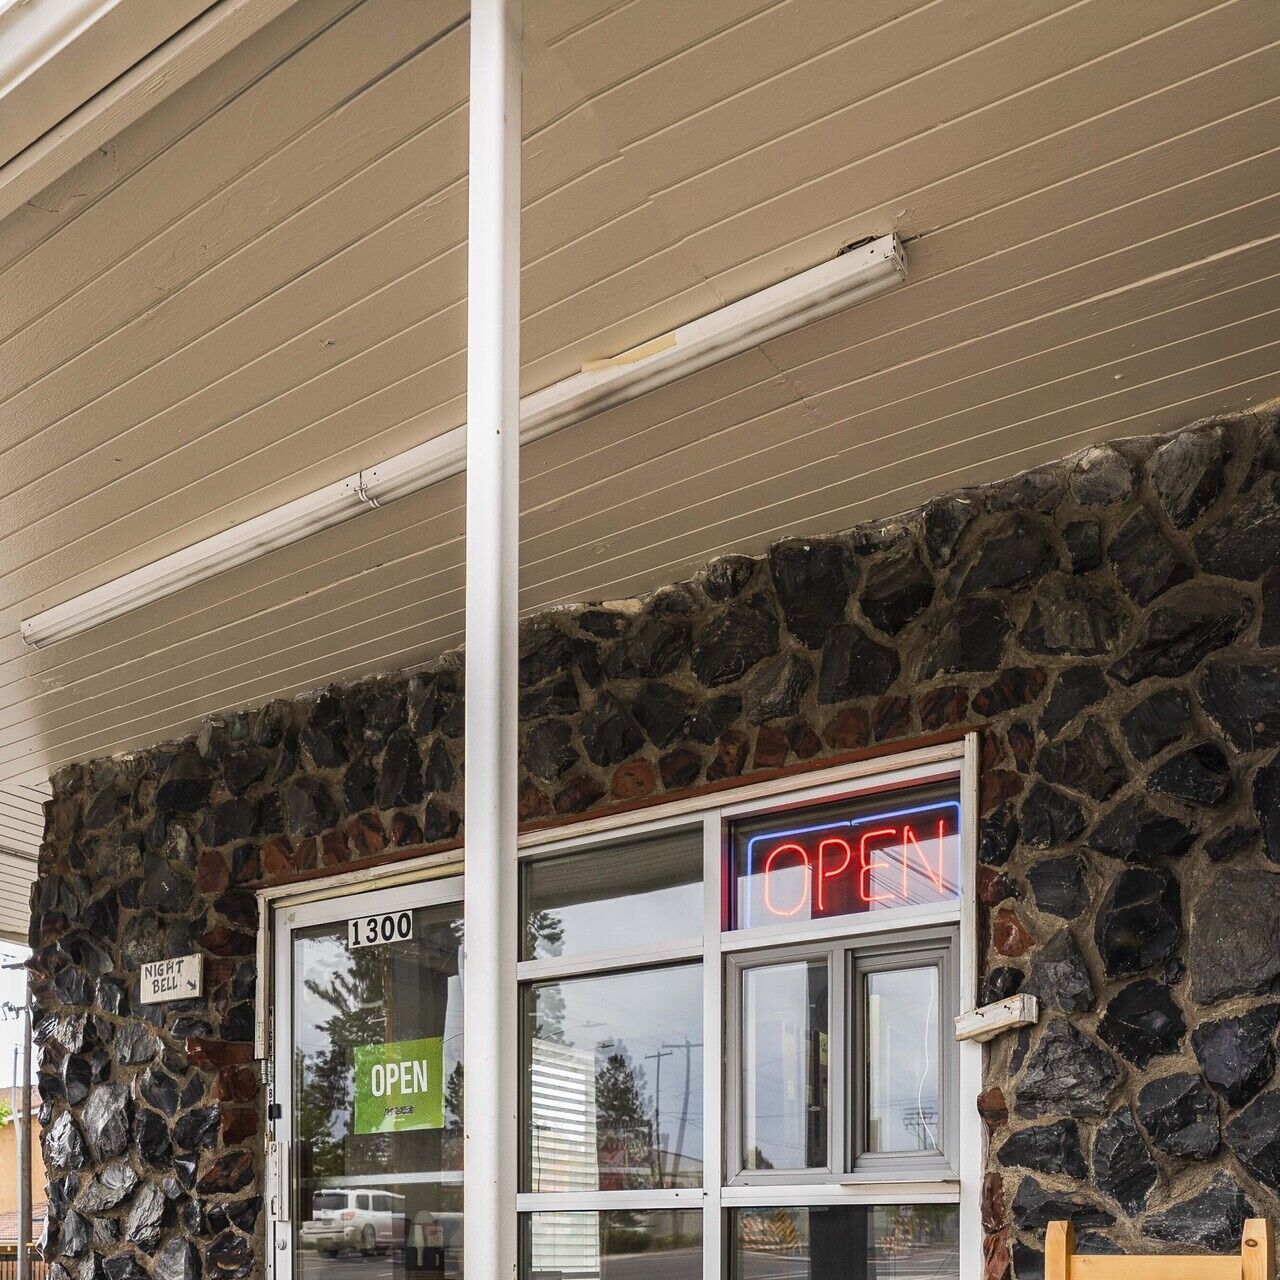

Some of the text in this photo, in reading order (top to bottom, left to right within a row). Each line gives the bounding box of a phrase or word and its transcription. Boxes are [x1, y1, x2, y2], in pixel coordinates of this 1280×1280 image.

[764, 819, 946, 916] OPEN
[351, 912, 412, 946] 1300
[145, 960, 184, 979] NIGHT
[152, 976, 178, 994] BELL
[371, 1060, 428, 1098] OPEN
